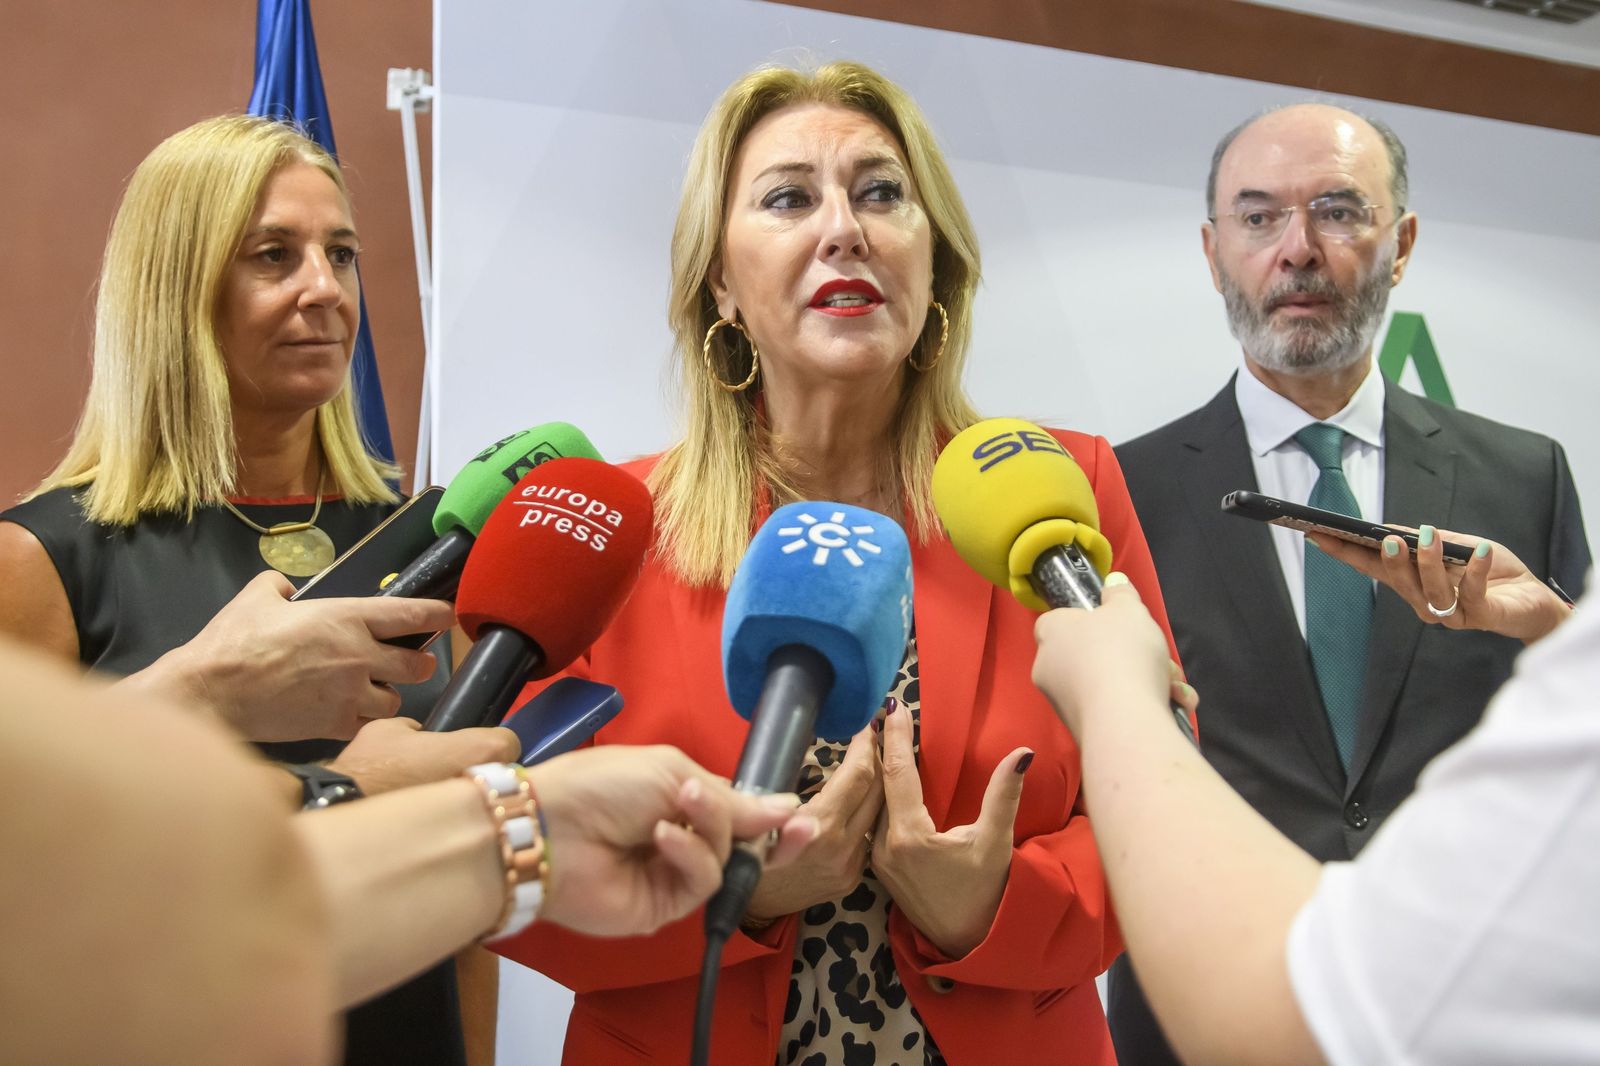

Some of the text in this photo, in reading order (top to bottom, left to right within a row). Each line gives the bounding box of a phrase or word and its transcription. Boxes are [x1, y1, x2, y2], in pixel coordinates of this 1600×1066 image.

[972, 431, 1070, 473] SE
[521, 483, 623, 527] europa
[519, 508, 609, 552] press
